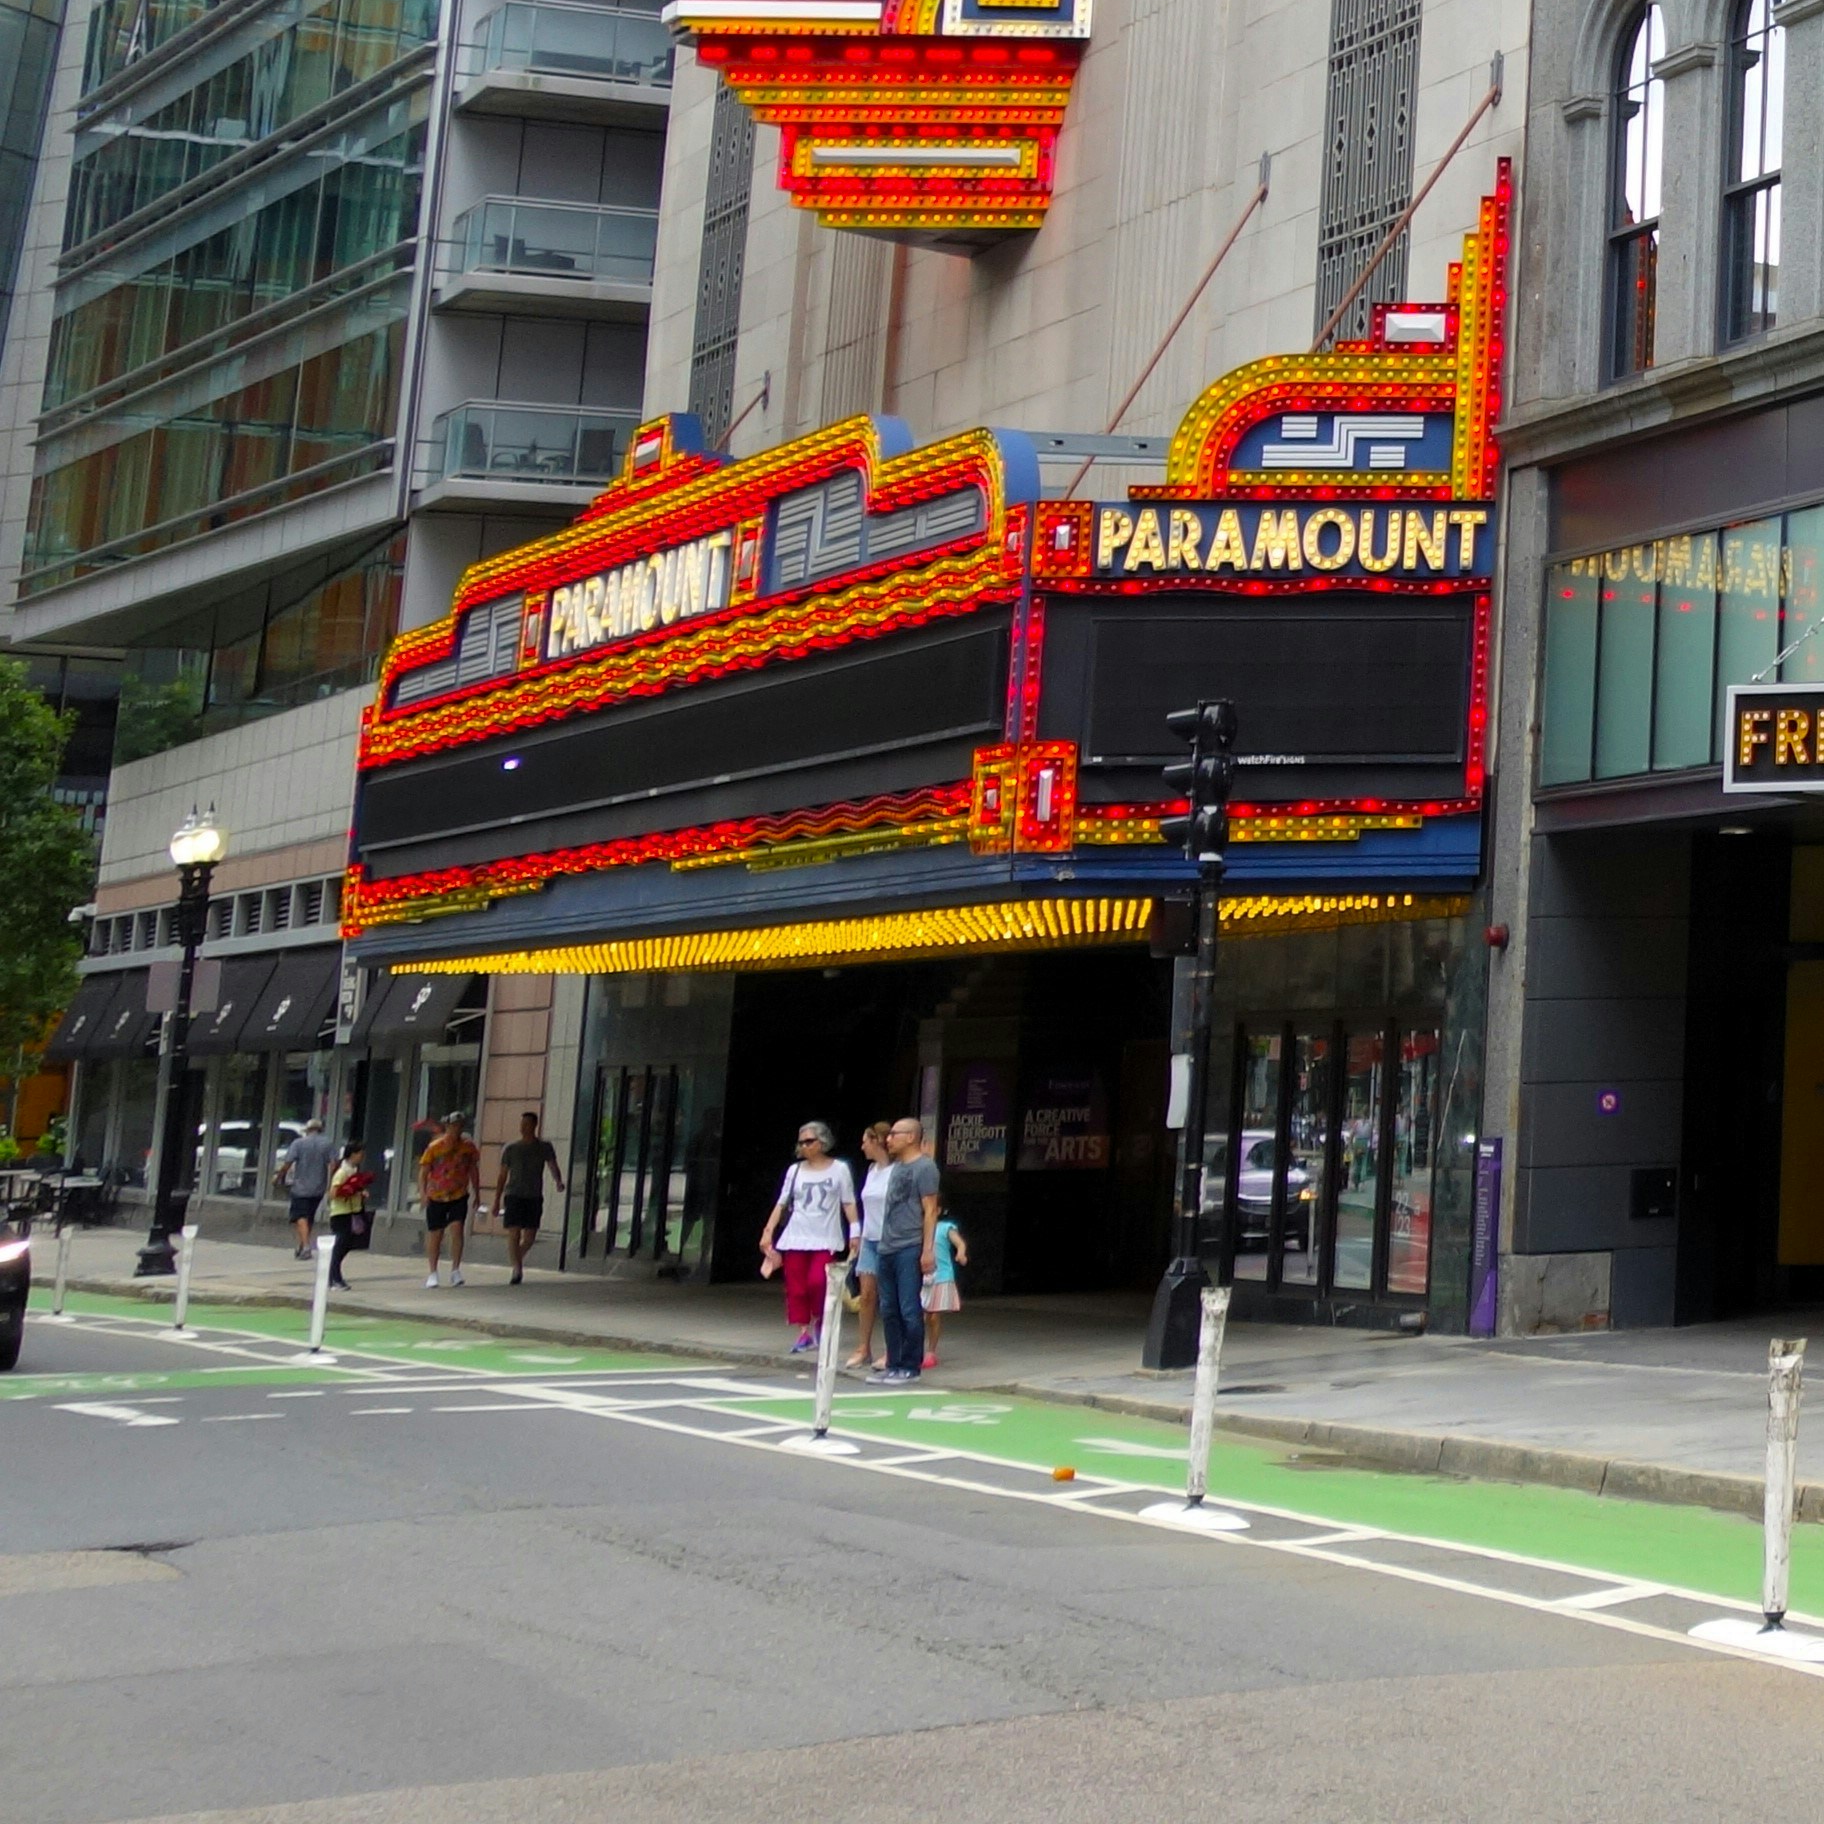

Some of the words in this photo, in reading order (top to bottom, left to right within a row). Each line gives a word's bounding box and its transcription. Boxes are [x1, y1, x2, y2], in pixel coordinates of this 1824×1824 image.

[1098, 508, 1487, 572] PARAMOUNT
[547, 530, 731, 658] PARAMOUNT
[1036, 1107, 1091, 1123] CREATIVE
[1045, 1136, 1102, 1161] ARTS
